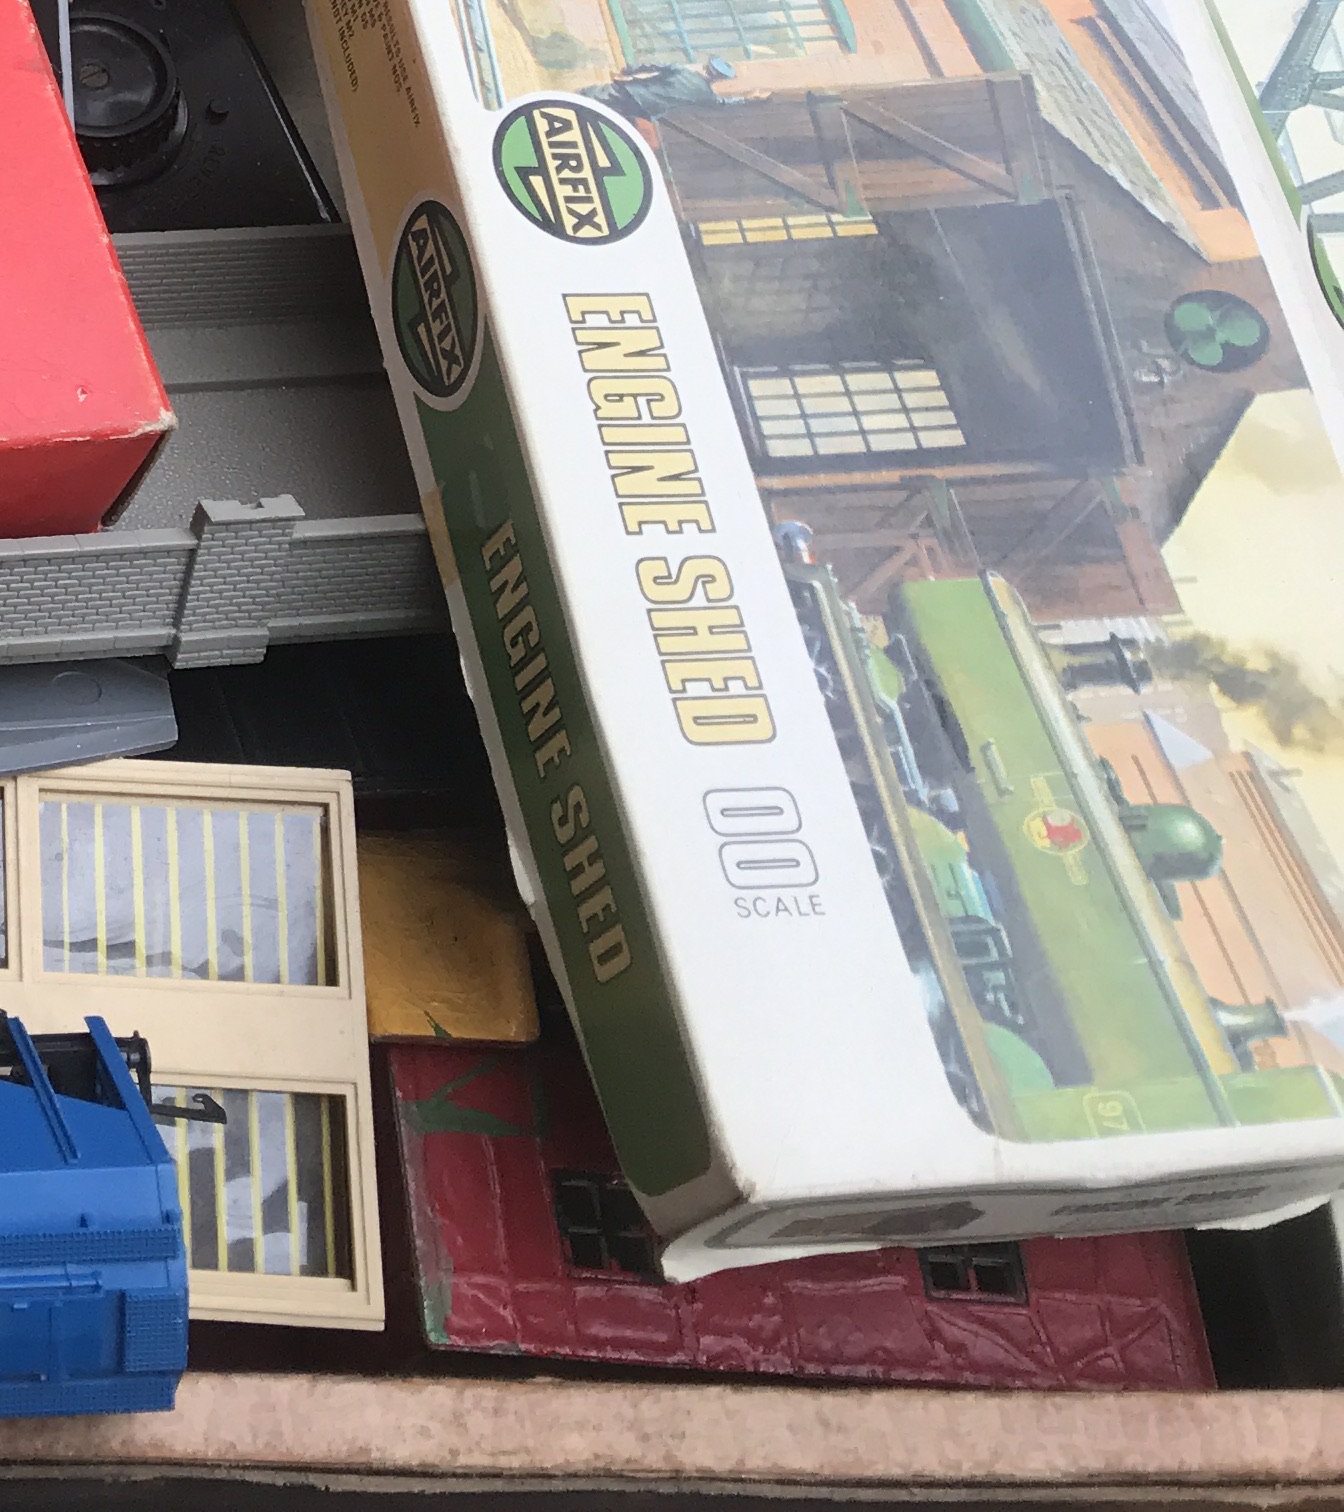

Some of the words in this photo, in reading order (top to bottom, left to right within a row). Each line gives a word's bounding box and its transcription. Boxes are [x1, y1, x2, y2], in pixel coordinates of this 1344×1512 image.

[539, 110, 606, 236] AIRFIX
[410, 230, 464, 374] AIRFIX
[562, 292, 717, 535] ENGINE
[635, 555, 778, 746] SHED
[481, 519, 573, 779] ENGINE
[550, 782, 634, 986] SHED
[733, 894, 827, 920] SCALE
